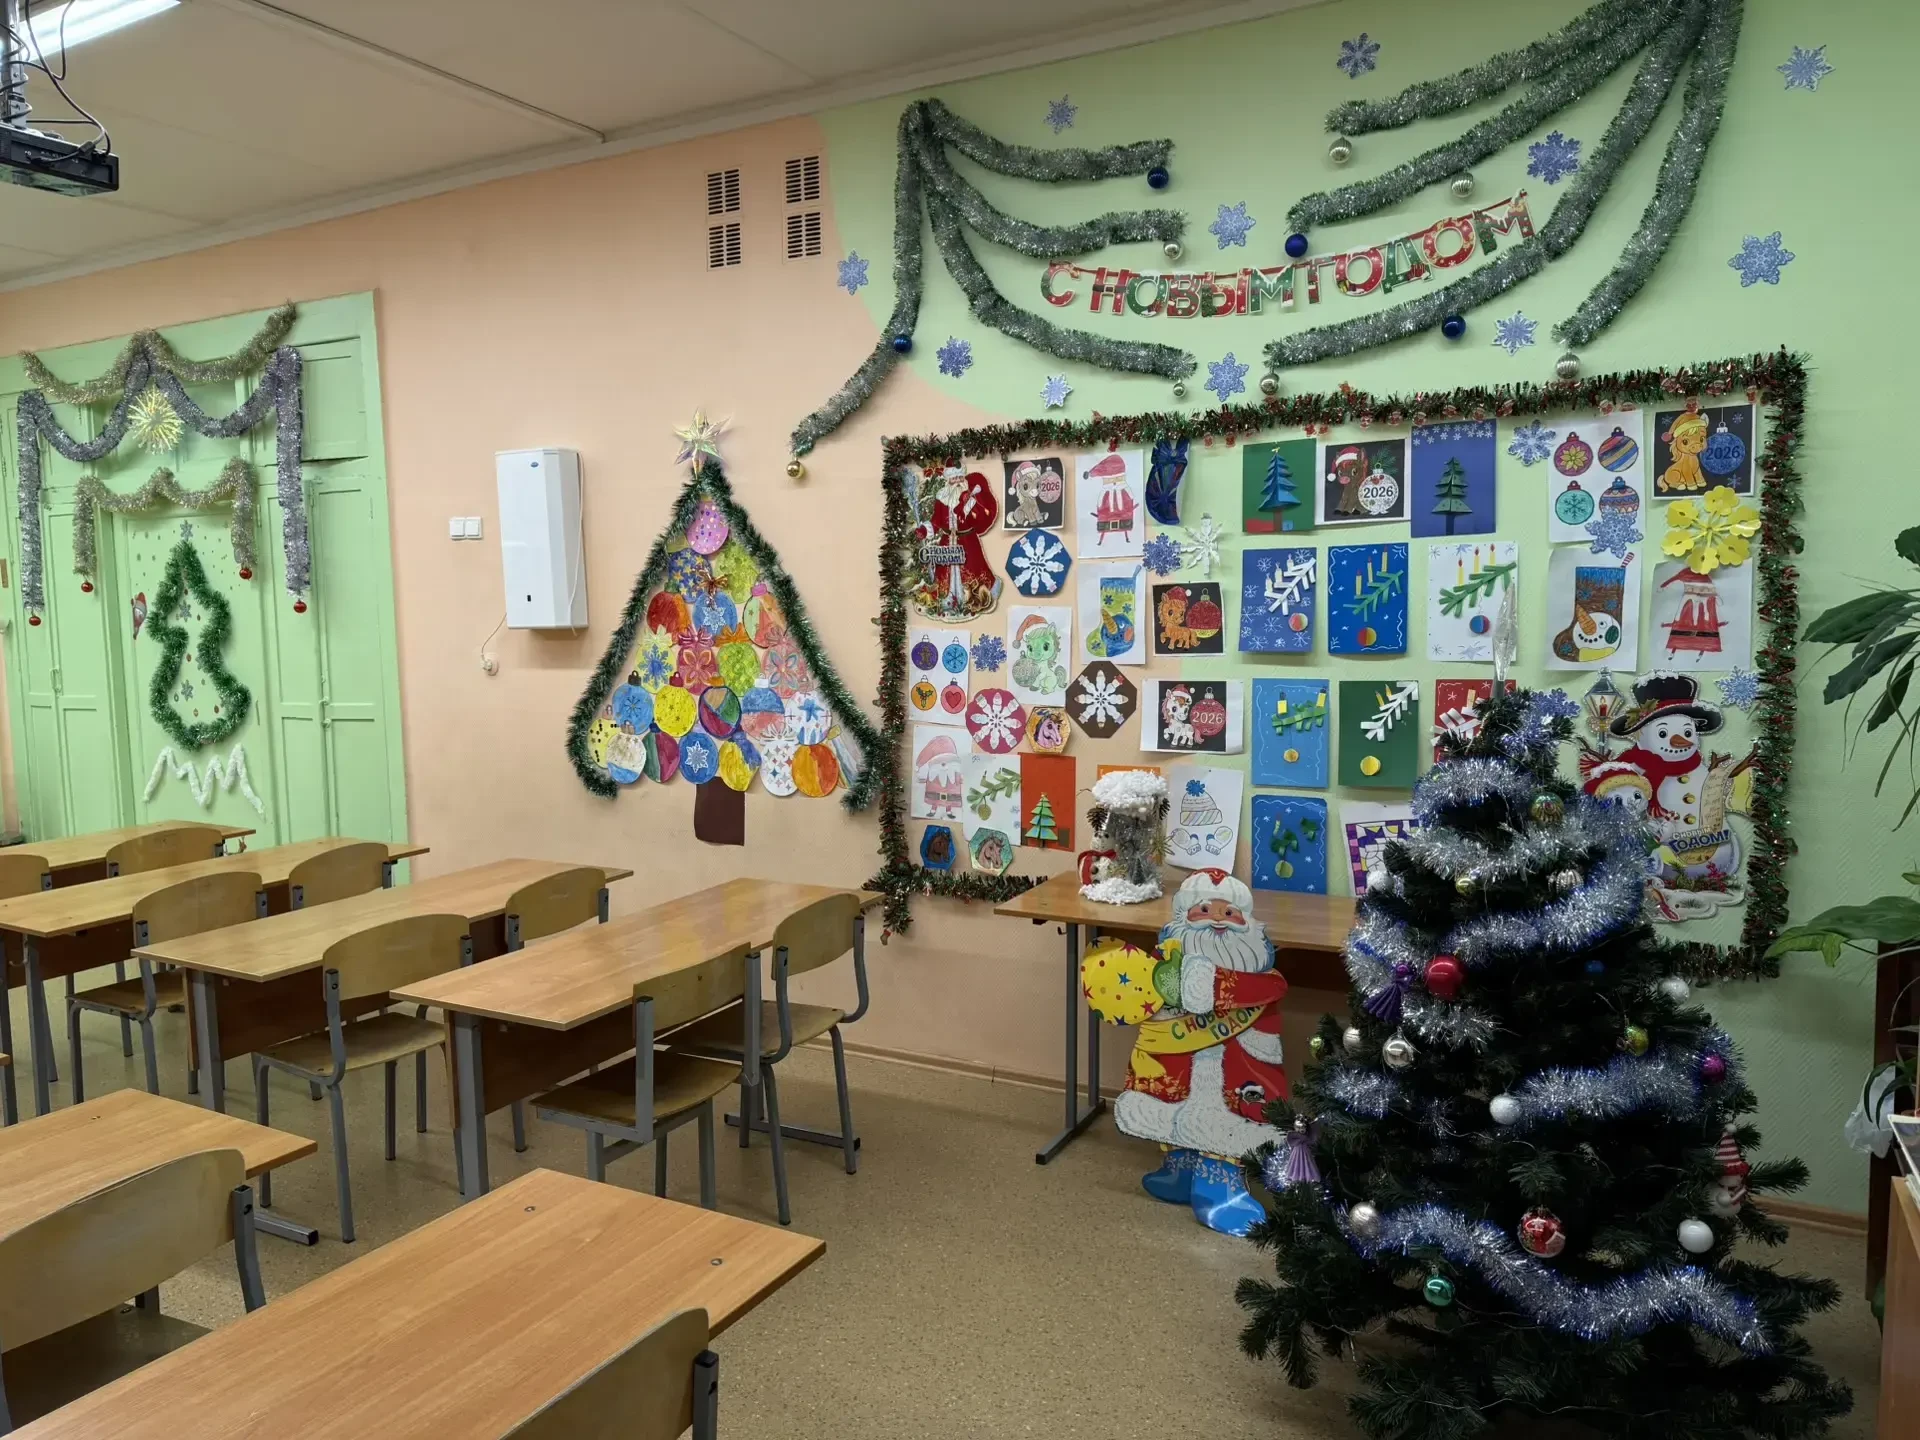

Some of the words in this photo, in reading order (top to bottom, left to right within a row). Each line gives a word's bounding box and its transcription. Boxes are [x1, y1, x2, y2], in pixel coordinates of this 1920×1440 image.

[1041, 260, 1080, 307] С
[1306, 190, 1536, 305] ГОДОМ
[1706, 445, 1741, 461] 2026
[1041, 481, 1060, 492] 2026
[1363, 486, 1394, 499] 2026
[1192, 711, 1223, 725] 2026
[1668, 829, 1730, 854] ГОДОМ!
[1171, 1021, 1186, 1040] С
